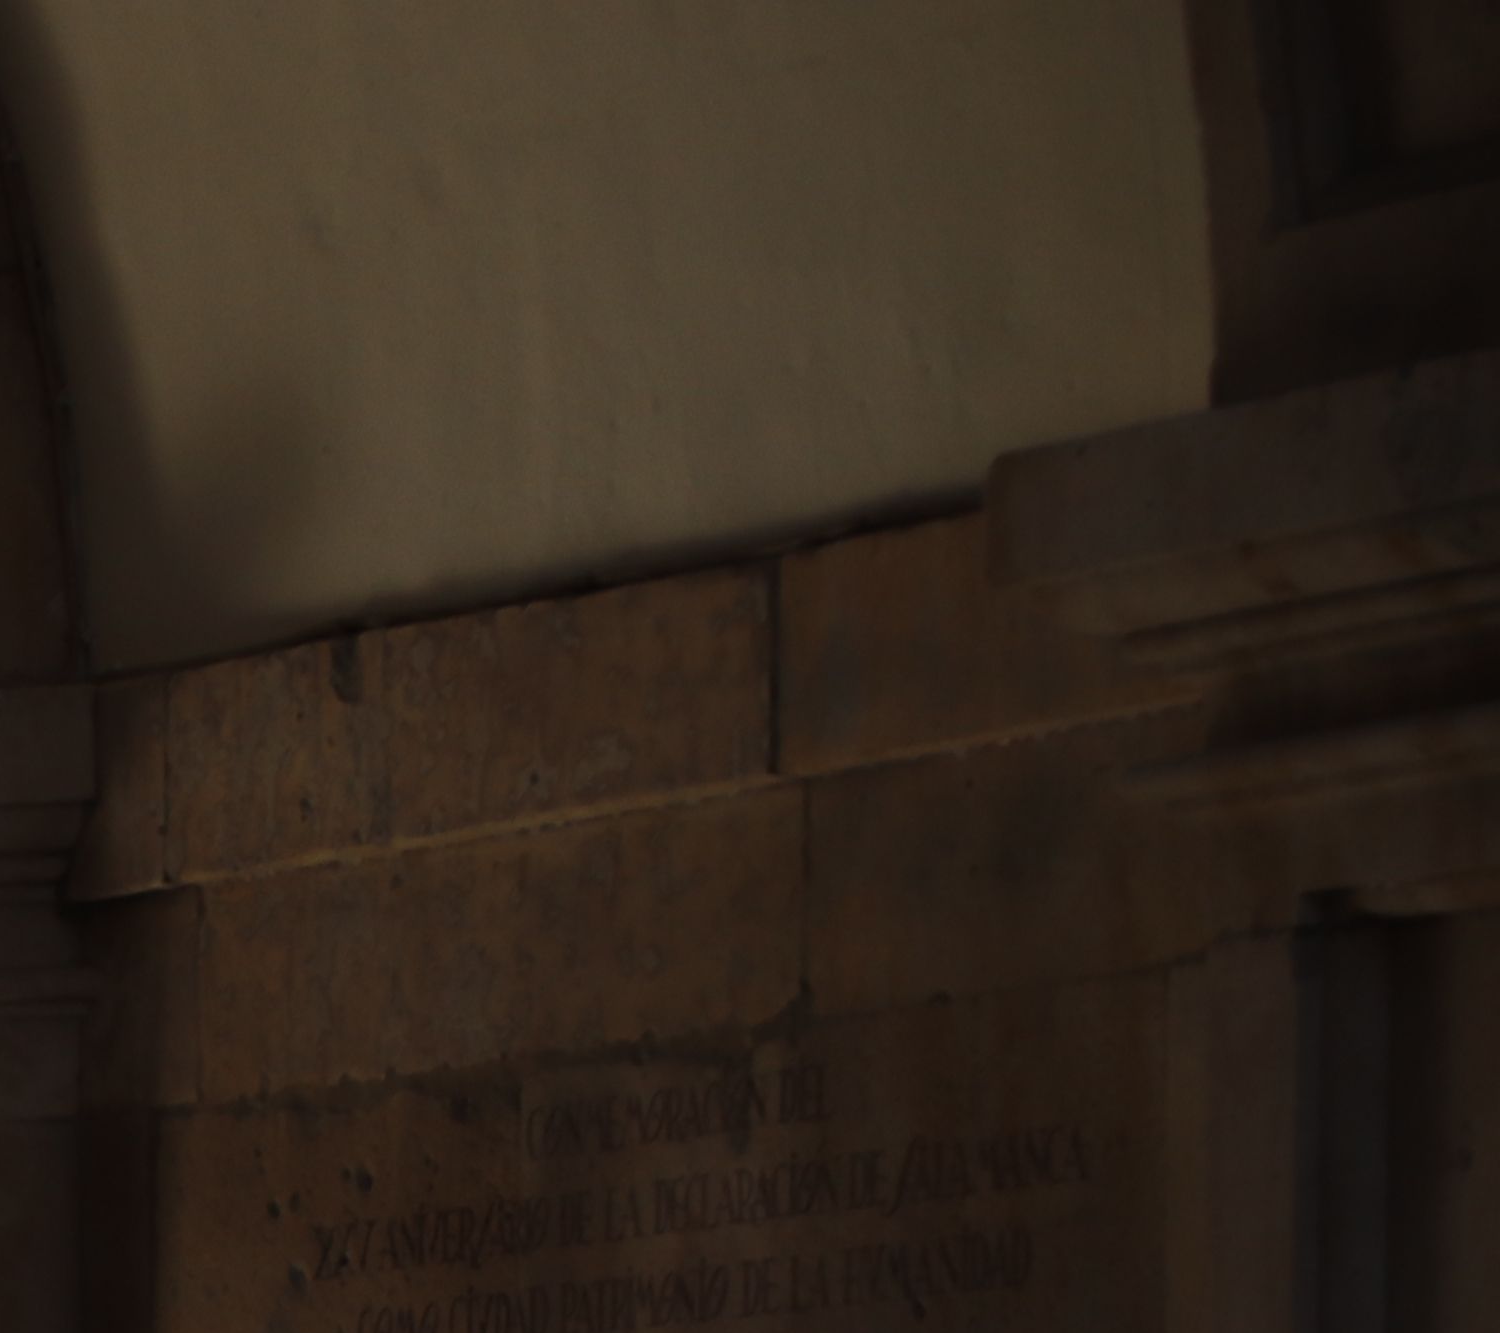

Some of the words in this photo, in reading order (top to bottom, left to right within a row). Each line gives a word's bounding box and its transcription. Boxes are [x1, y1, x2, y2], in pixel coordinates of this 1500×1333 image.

[778, 1063, 835, 1124] DEL
[559, 1190, 594, 1246] DE
[604, 1185, 642, 1243] LA
[846, 1149, 888, 1210] DE
[740, 1257, 780, 1318] DE
[790, 1254, 830, 1314] LA
